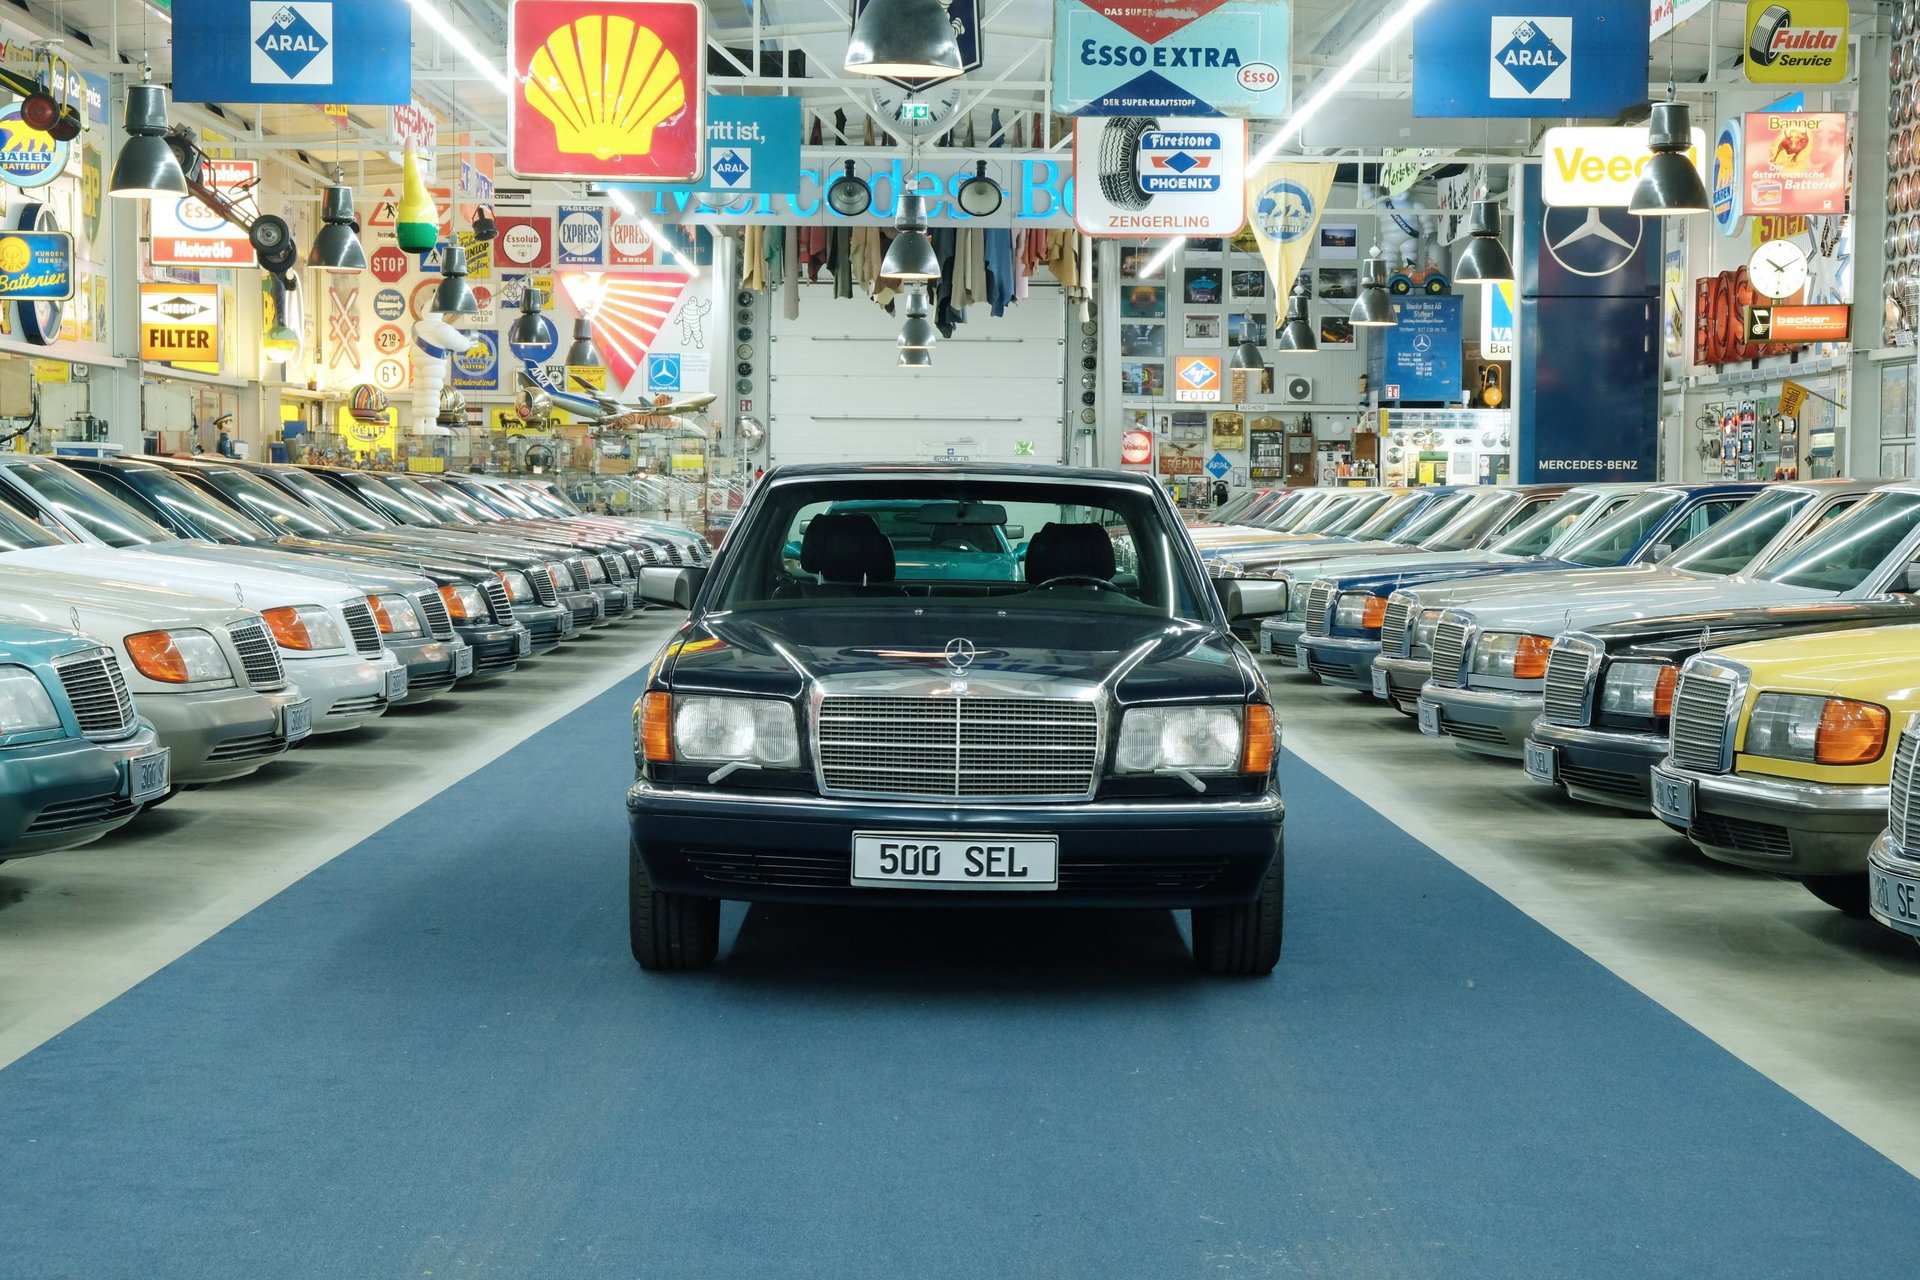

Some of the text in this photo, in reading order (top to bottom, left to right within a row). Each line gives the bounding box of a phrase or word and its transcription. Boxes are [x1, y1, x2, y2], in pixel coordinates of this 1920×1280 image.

[1104, 8, 1122, 16] DAS
[265, 35, 320, 51] ARAL
[1772, 30, 1838, 50] Fulda
[1153, 47, 1241, 67] EXTRA
[1503, 50, 1559, 66] ARAL
[1779, 54, 1832, 67] Service
[1103, 98, 1196, 107] DER SUPER-KRAFTSTOFF
[1769, 116, 1822, 130] Banner
[706, 121, 766, 144] ritt ist,
[1149, 133, 1213, 148] Firestone
[3, 163, 46, 171] BATTERIE
[717, 163, 745, 173] ARAL
[1769, 163, 1784, 171] Die
[1150, 178, 1213, 189] PHOENIX
[1784, 180, 1837, 190] Batterie
[184, 202, 222, 219] Ess
[1109, 215, 1210, 228] ZENGERLING
[506, 235, 539, 243] Essolub
[563, 224, 599, 244] EXPRESS
[173, 240, 234, 259] Motoröle
[373, 258, 405, 272] STOP
[0, 270, 66, 292] Batterien
[149, 329, 210, 349] FILTER
[1181, 390, 1216, 400] FOTO
[1208, 461, 1229, 470] ARAL
[1539, 460, 1638, 470] MERCEDES-BENZ
[1667, 784, 1680, 812] SE
[880, 844, 1028, 878] 500 SEL
